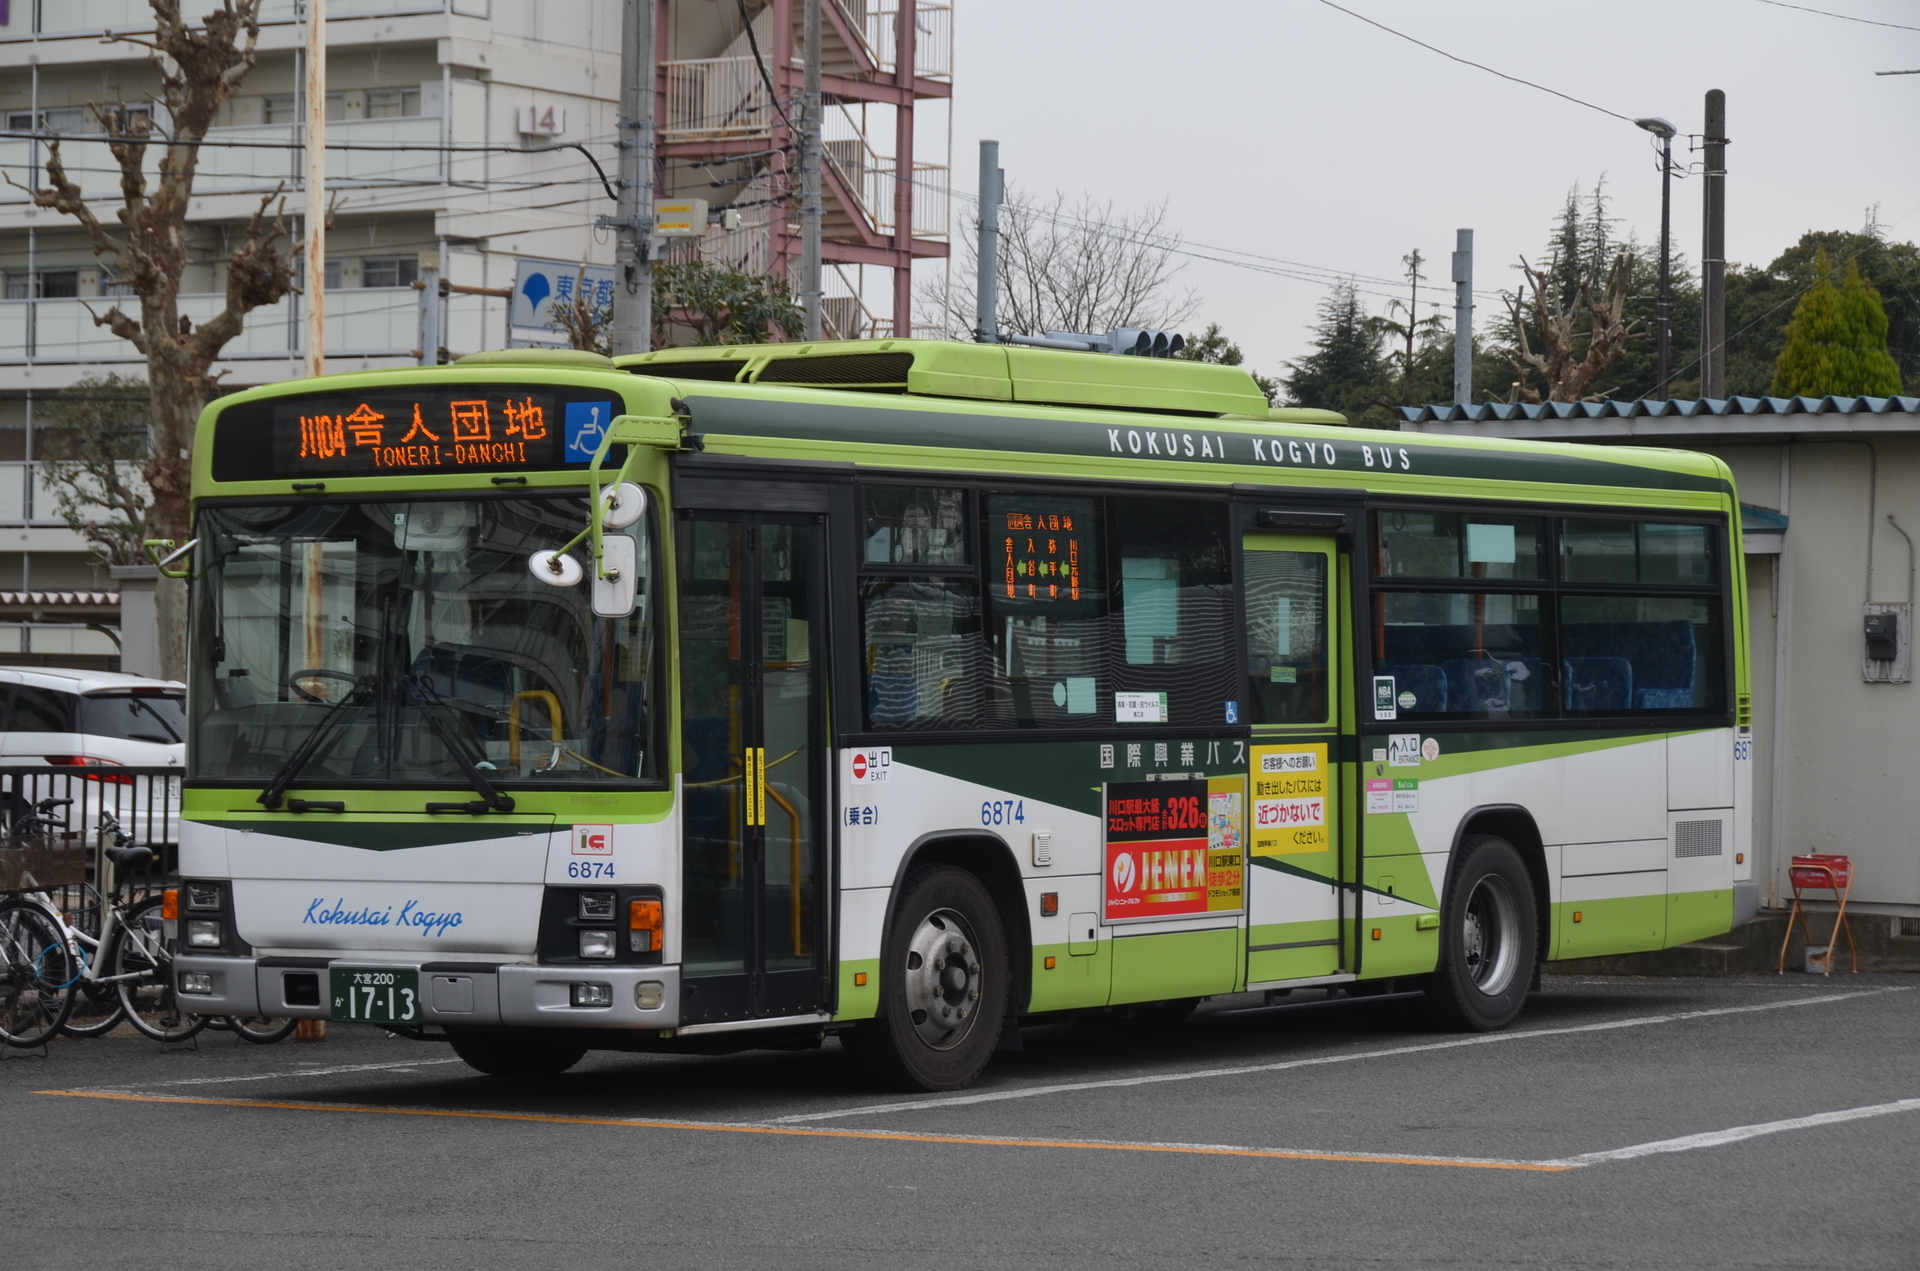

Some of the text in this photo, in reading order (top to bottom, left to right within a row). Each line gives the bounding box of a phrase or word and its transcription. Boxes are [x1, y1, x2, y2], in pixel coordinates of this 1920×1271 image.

[530, 106, 556, 131] 14
[346, 397, 546, 445] 舎人団地
[371, 441, 527, 468] TONERI-DANCHI
[1107, 429, 1410, 470] KOKUSAI KOGYO BUS
[1378, 686, 1391, 696] NBA
[1401, 737, 1417, 752] 入口
[868, 751, 890, 768] 出口
[1100, 741, 1245, 769] 国際興業バス
[1263, 755, 1315, 770] お客様へのお願い
[871, 771, 887, 781] EXIT
[1256, 779, 1321, 796] 動き出したバスには
[843, 805, 878, 827] (乗合)
[981, 800, 1025, 825] 6874
[1108, 798, 1160, 815] 川口駅最大級
[1168, 796, 1199, 830] 326
[1258, 803, 1320, 825] 近づかないで
[1108, 815, 1160, 832] スロット専門店
[1292, 831, 1324, 845] ください。
[568, 861, 615, 879] 6874
[1140, 849, 1207, 891] JENEX
[1208, 855, 1241, 868] 川口駅東口
[1209, 870, 1241, 887] 徒歩2分
[302, 897, 463, 938] Kokusai Kogyo
[335, 986, 415, 1020] か 17-13
